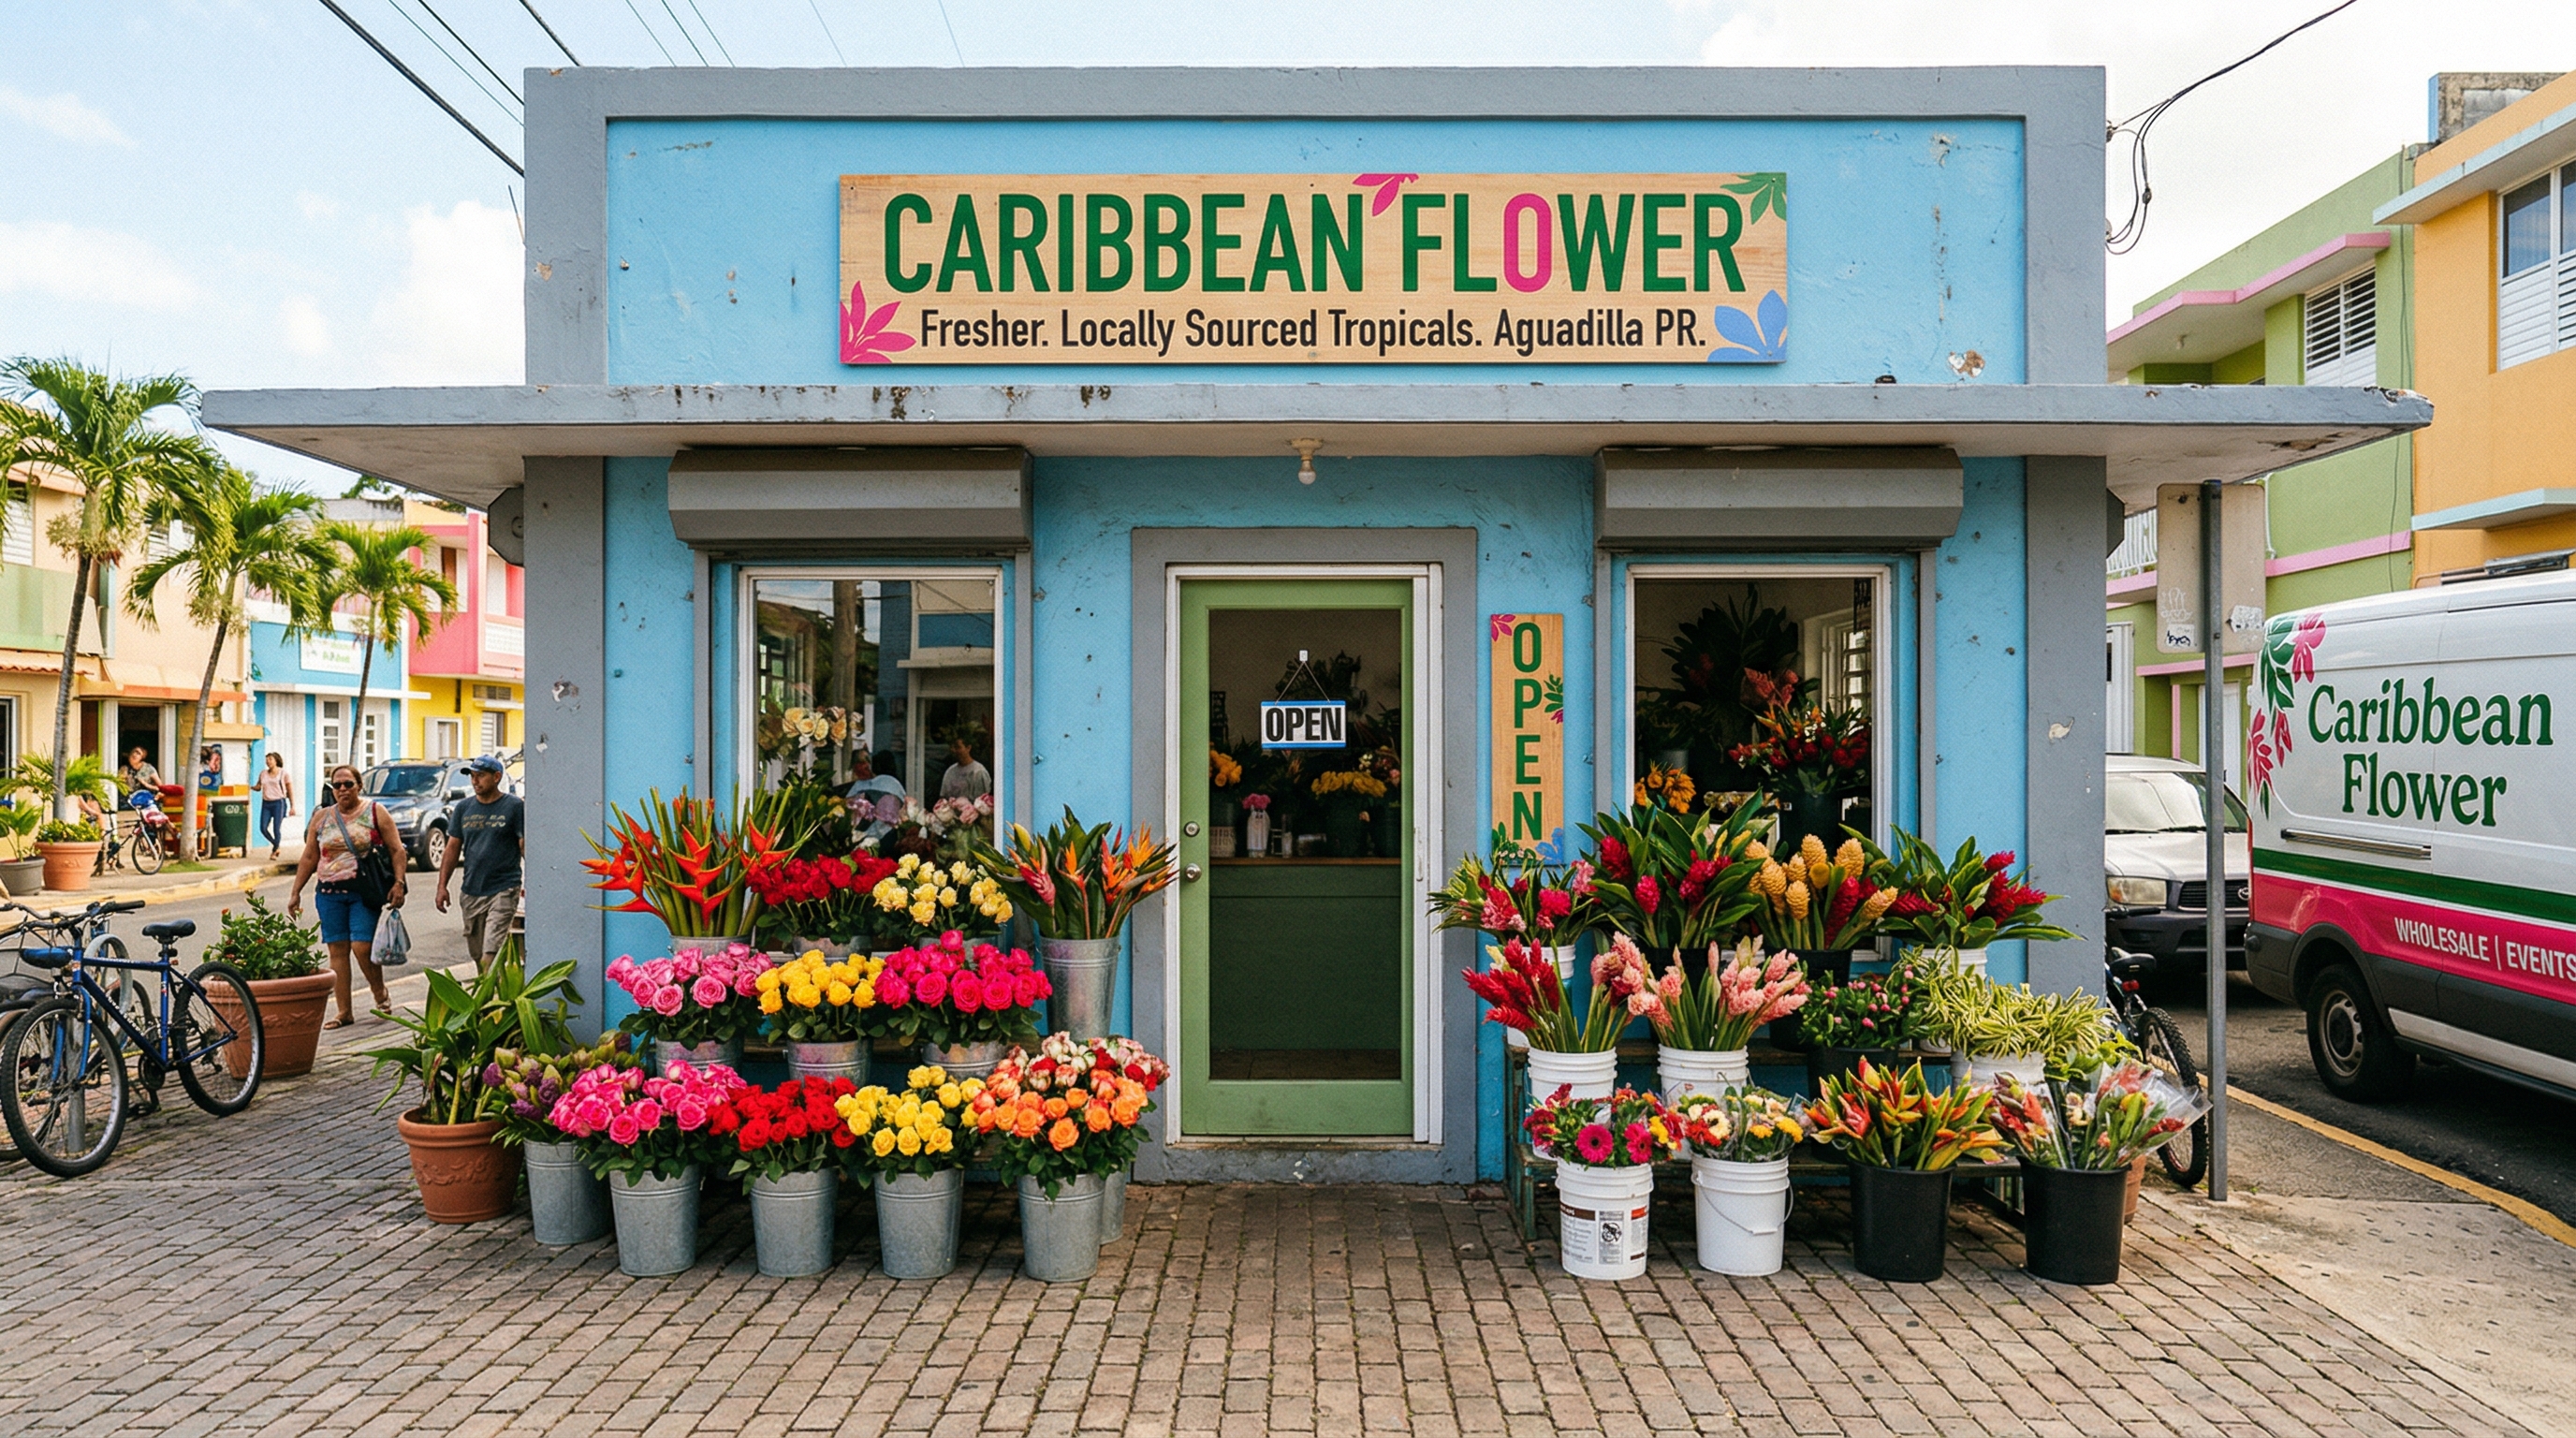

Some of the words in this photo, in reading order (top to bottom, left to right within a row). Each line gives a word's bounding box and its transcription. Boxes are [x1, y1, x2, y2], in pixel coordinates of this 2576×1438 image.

[884, 193, 1363, 293] CARIBBEAN
[1402, 193, 1746, 293] FLOWER
[921, 309, 1048, 347] Fresher.
[1061, 309, 1176, 358] Locally
[1185, 308, 1318, 347] Sourced
[1327, 309, 1483, 357] Tropicals.
[1494, 309, 1644, 357] Aguadilla
[1655, 309, 1706, 346] PR.
[1265, 707, 1342, 742] OPEN
[1513, 622, 1543, 841] OPEN
[2308, 676, 2554, 746] Caribbean
[2341, 752, 2508, 828] Flower
[2394, 917, 2490, 962] WHOLESALE
[2506, 941, 2576, 982] EVENTS
